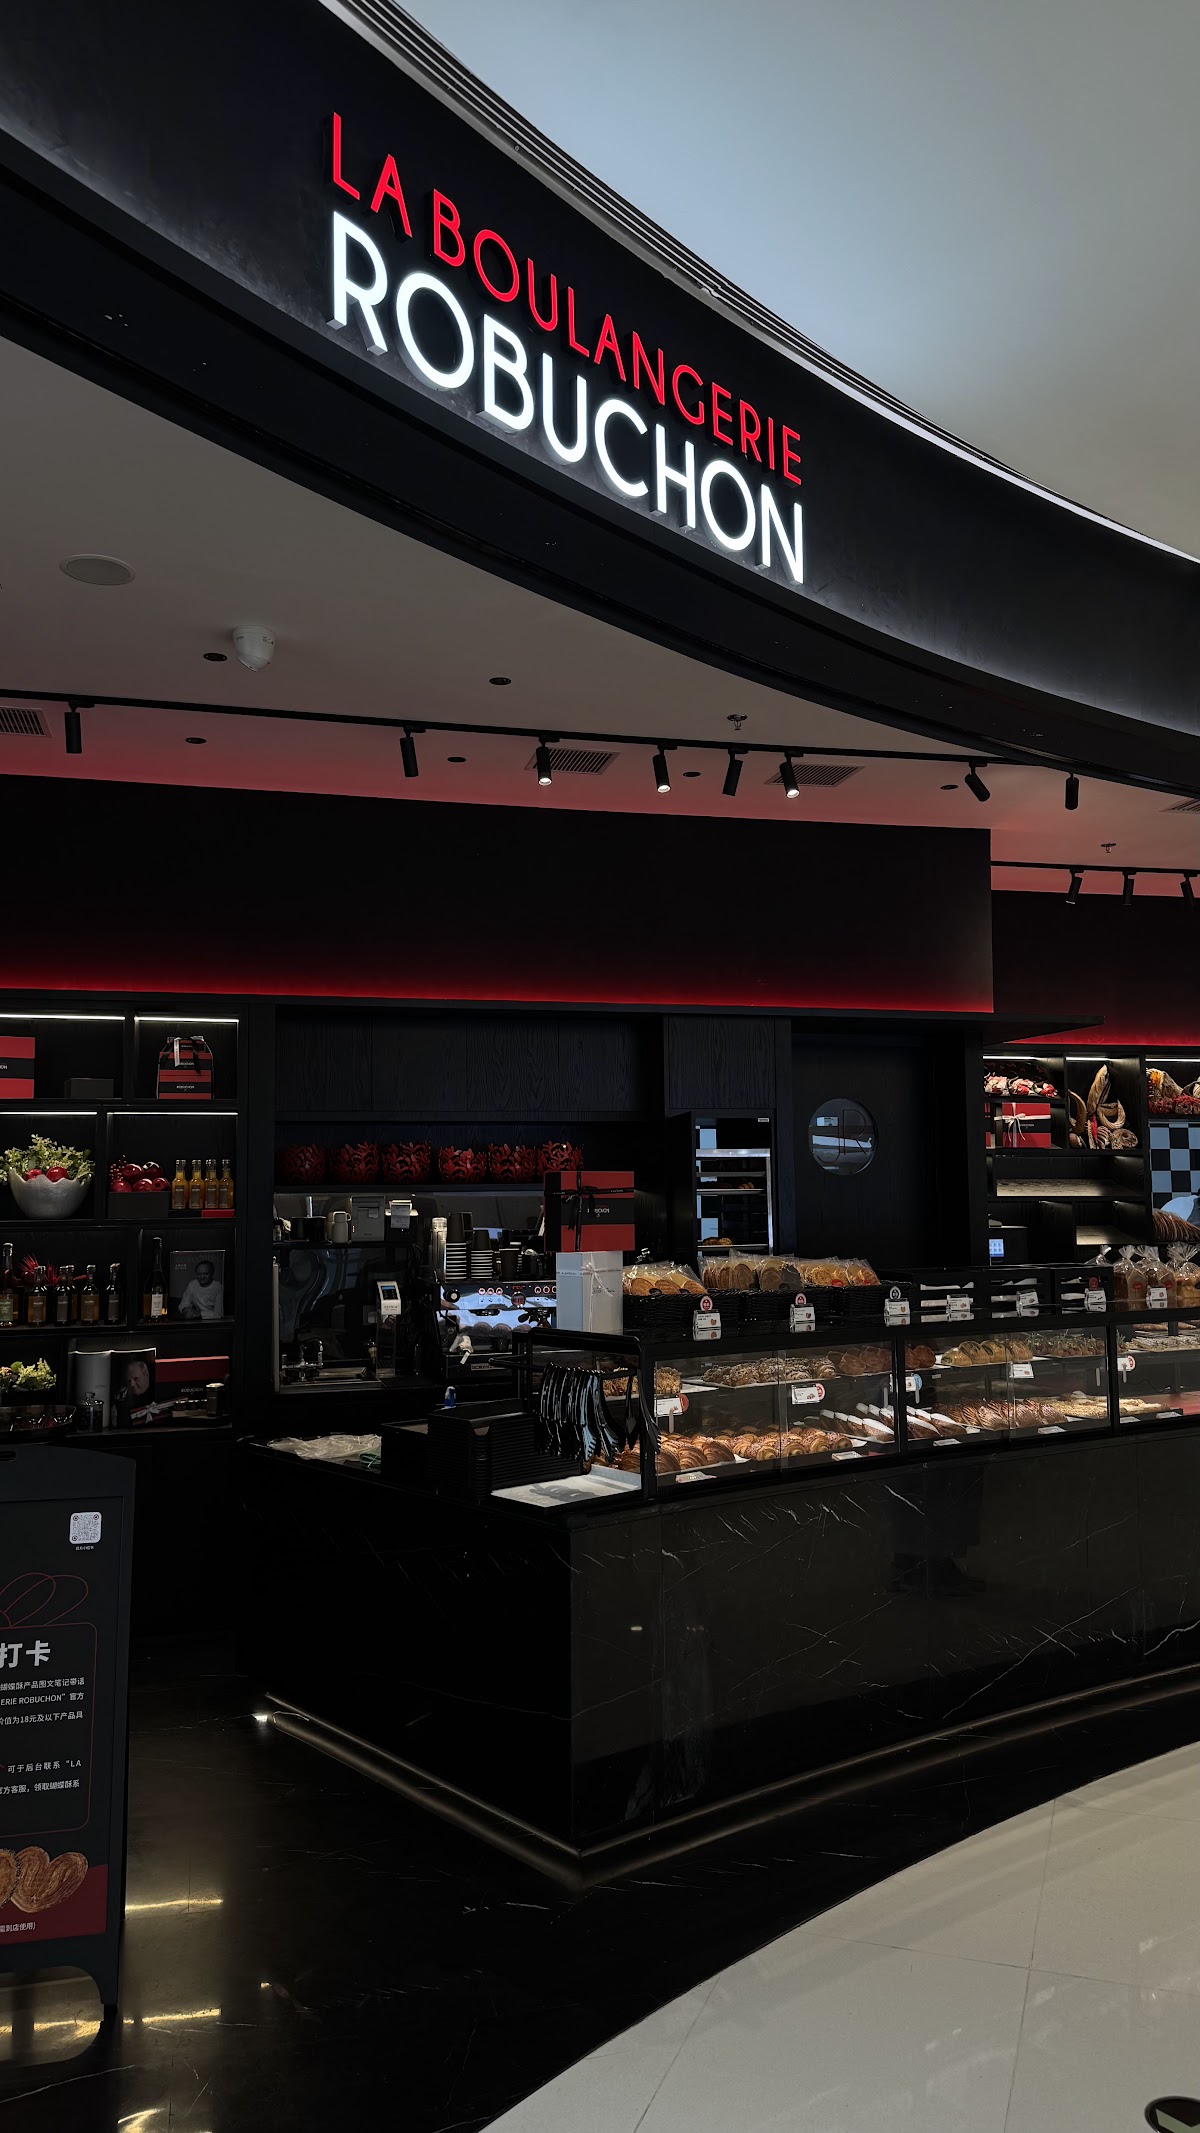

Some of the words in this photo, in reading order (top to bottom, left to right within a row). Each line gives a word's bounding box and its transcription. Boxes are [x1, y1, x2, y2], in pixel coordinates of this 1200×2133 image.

[332, 112, 413, 239] LA
[432, 188, 802, 486] BOULANGERIE
[332, 210, 804, 585] ROBUCHON
[0, 1639, 51, 1669] 打卡
